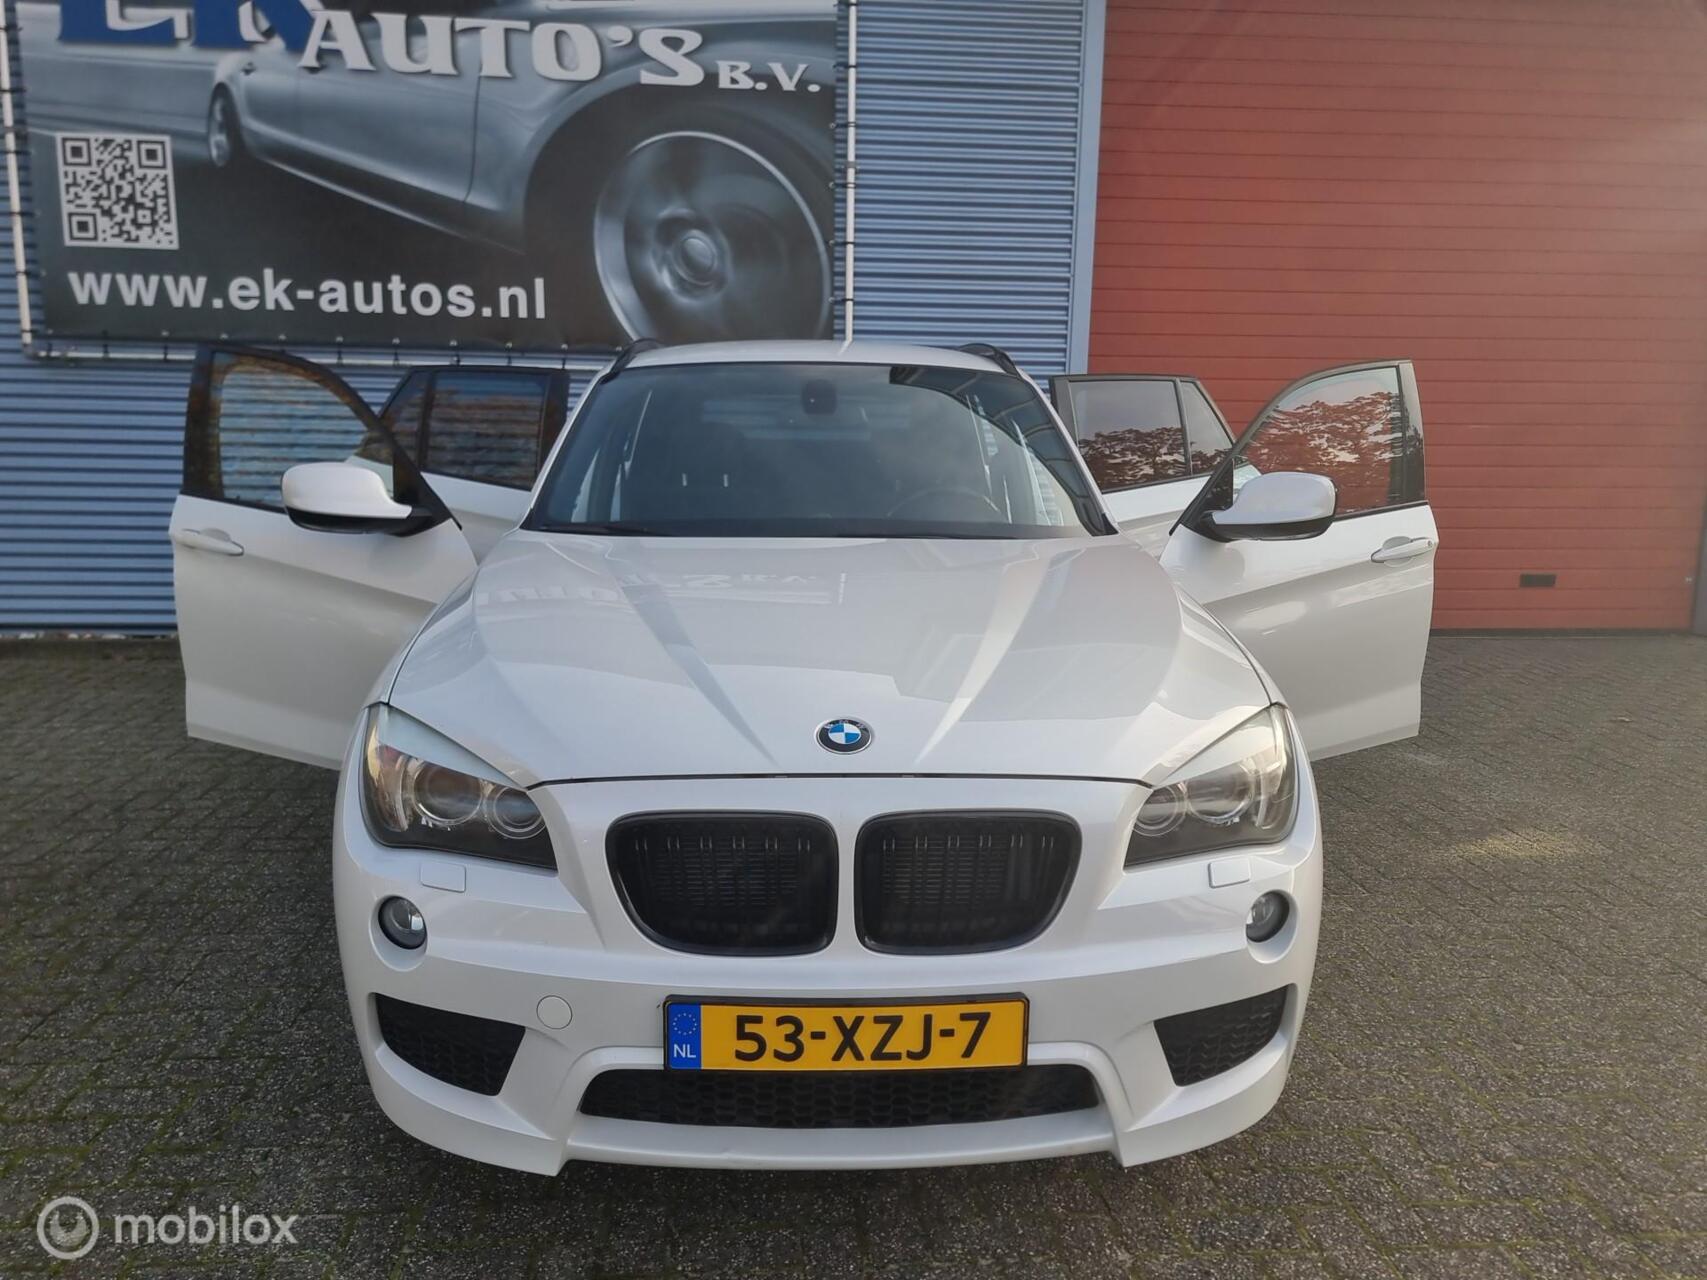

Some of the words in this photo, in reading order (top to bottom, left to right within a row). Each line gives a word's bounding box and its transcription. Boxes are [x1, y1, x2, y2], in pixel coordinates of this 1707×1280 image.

[298, 9, 704, 87] AUTO'S
[715, 60, 821, 92] B.V.
[67, 267, 546, 319] www.ek-autos.nl
[673, 1043, 697, 1058] NL
[734, 1011, 992, 1062] 53-XZJ-7
